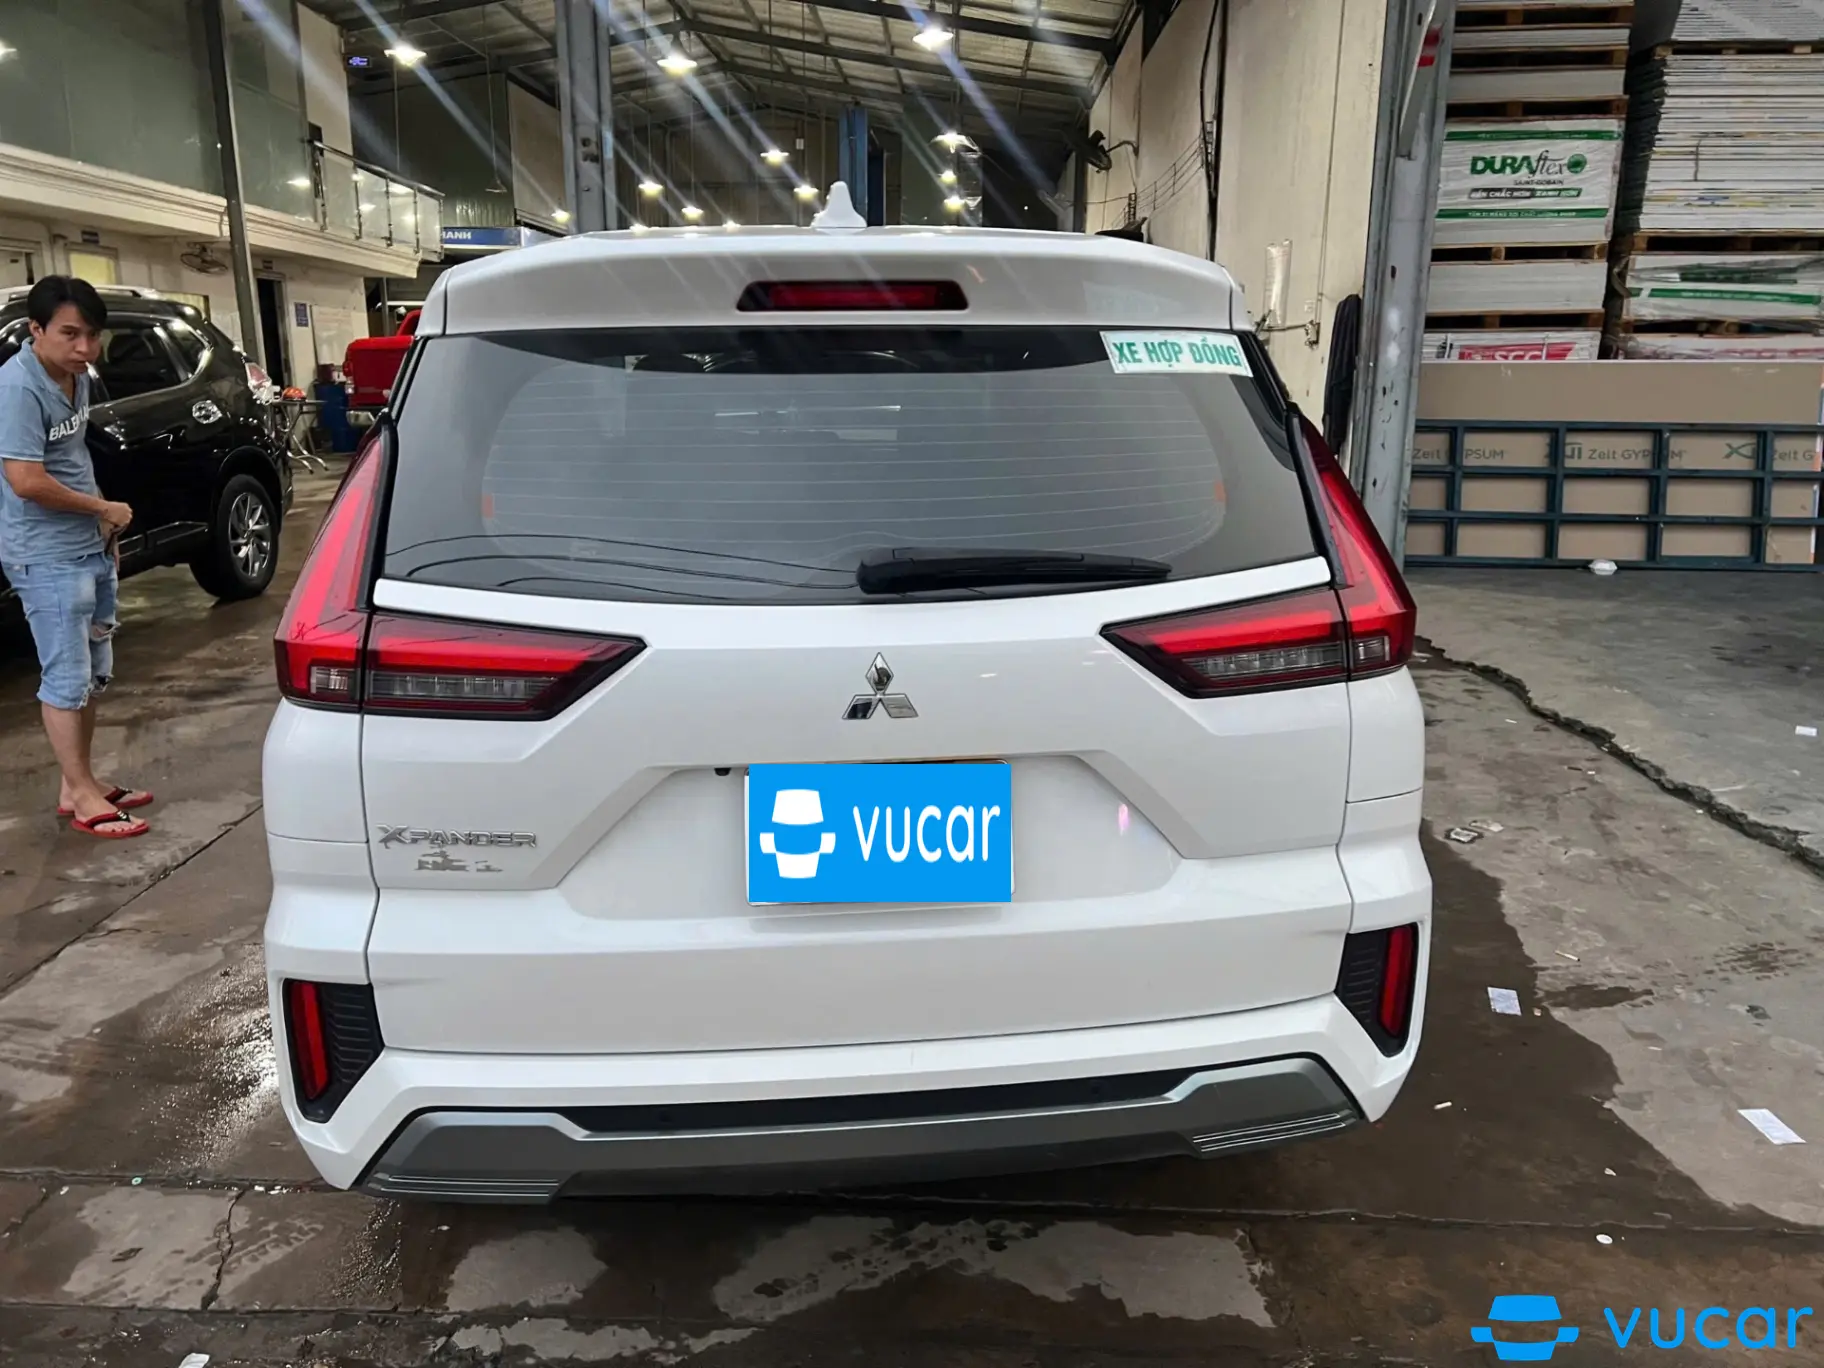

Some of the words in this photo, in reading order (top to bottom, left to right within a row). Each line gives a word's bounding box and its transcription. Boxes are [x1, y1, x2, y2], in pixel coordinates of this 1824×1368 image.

[1112, 342, 1143, 364] XE
[1143, 339, 1184, 368] HỢP
[1187, 336, 1243, 367] ĐỒNG
[1588, 448, 1616, 460] Zeit
[375, 824, 538, 849] XPANDER
